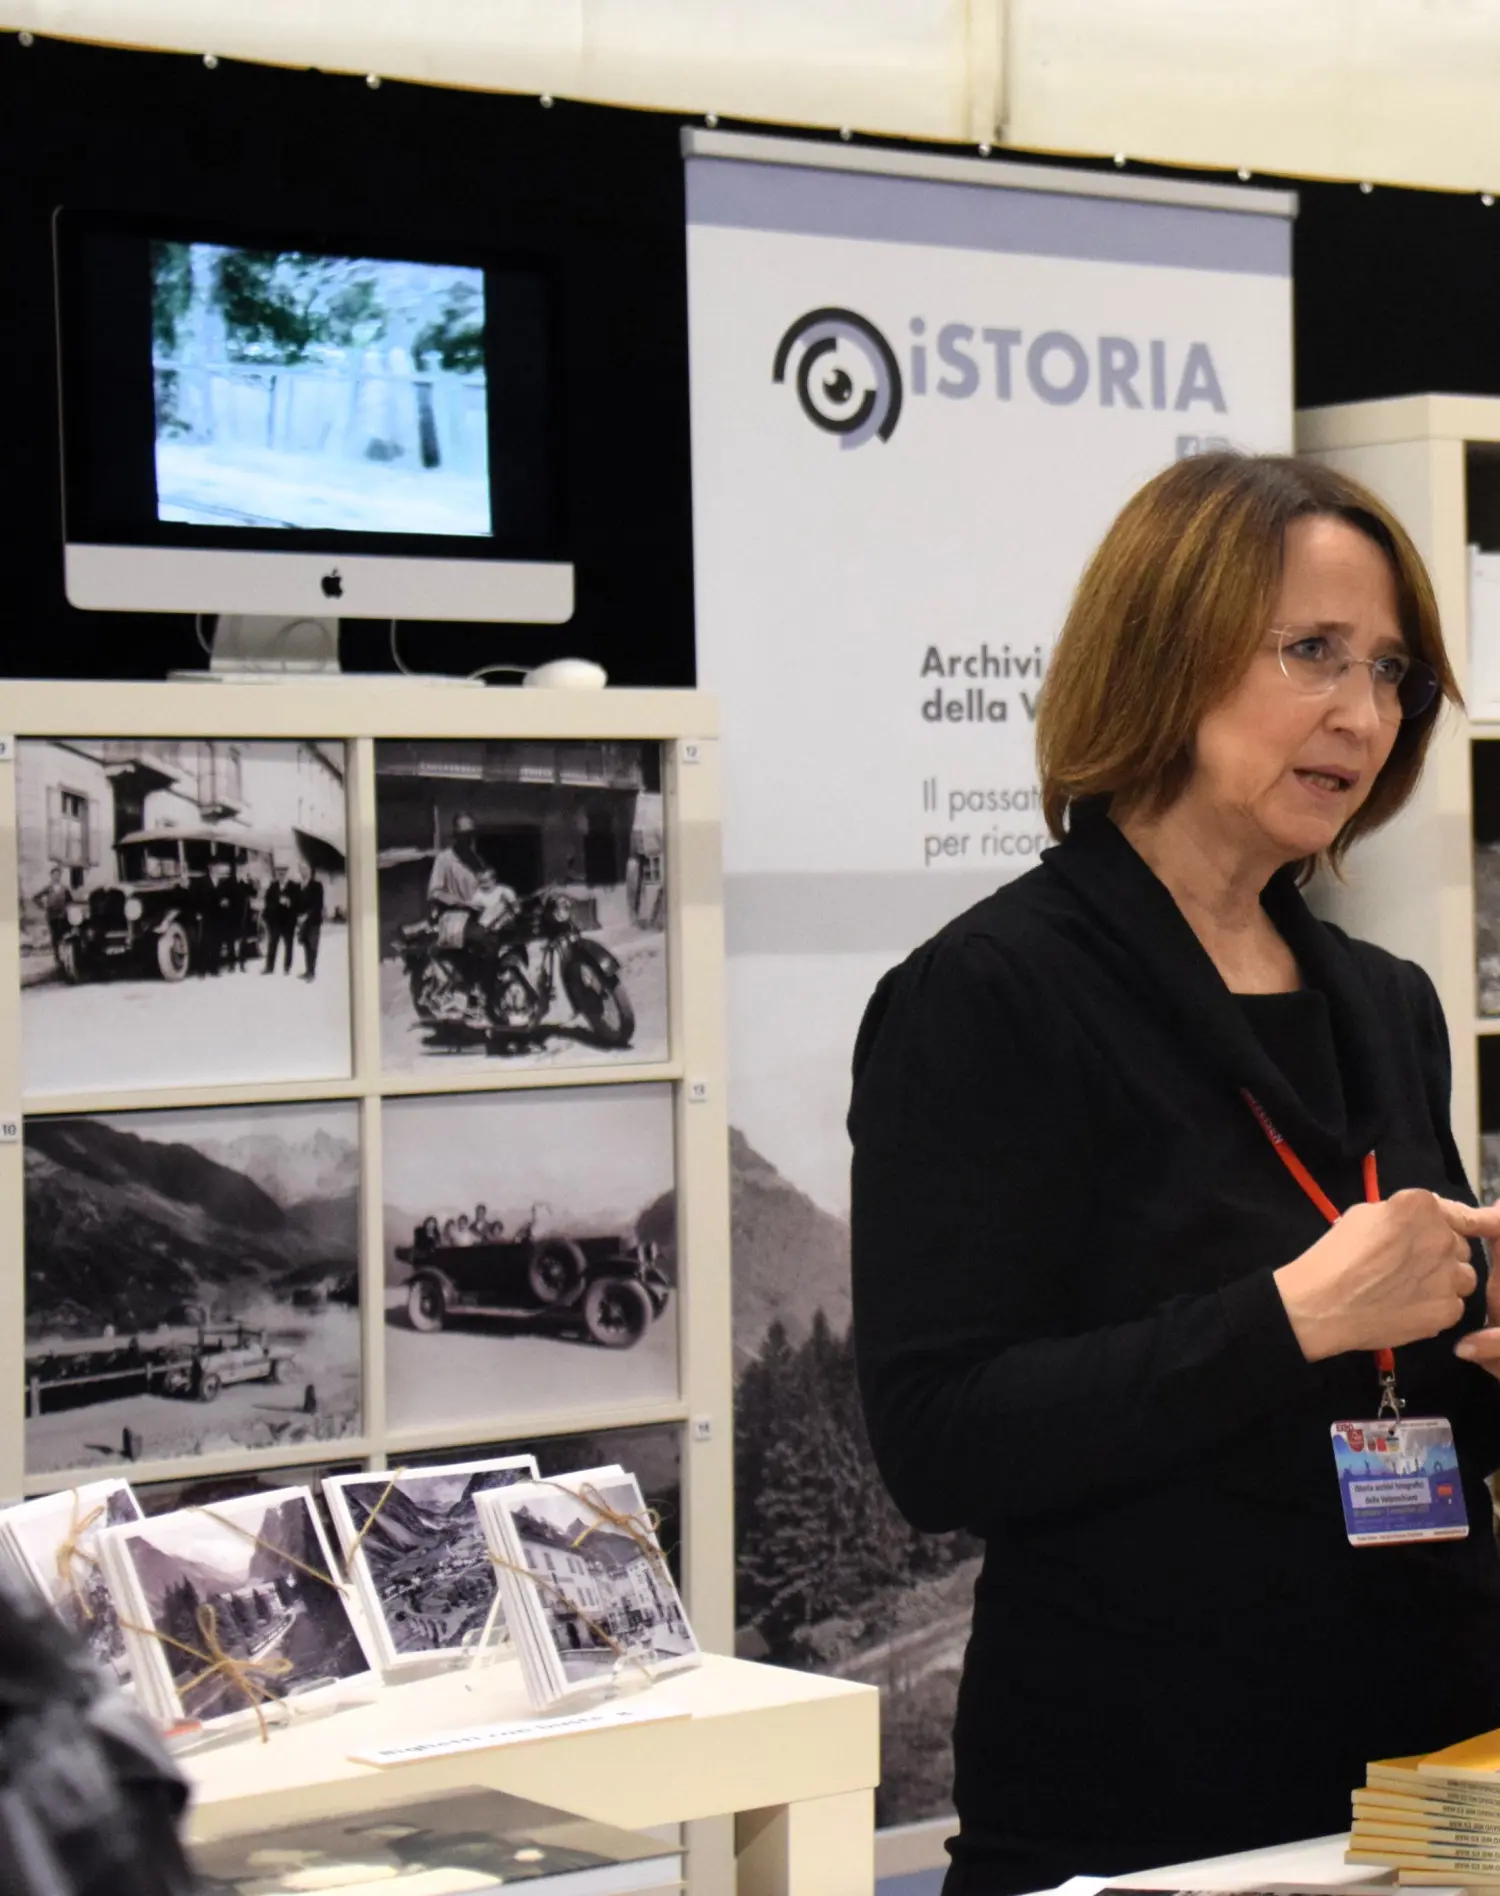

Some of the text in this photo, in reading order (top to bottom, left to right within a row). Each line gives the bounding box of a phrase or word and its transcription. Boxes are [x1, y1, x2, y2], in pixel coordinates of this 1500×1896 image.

[908, 316, 1229, 414] iSTORIA
[920, 643, 1042, 679] Archivi
[921, 687, 1008, 723] della
[924, 832, 970, 868] per
